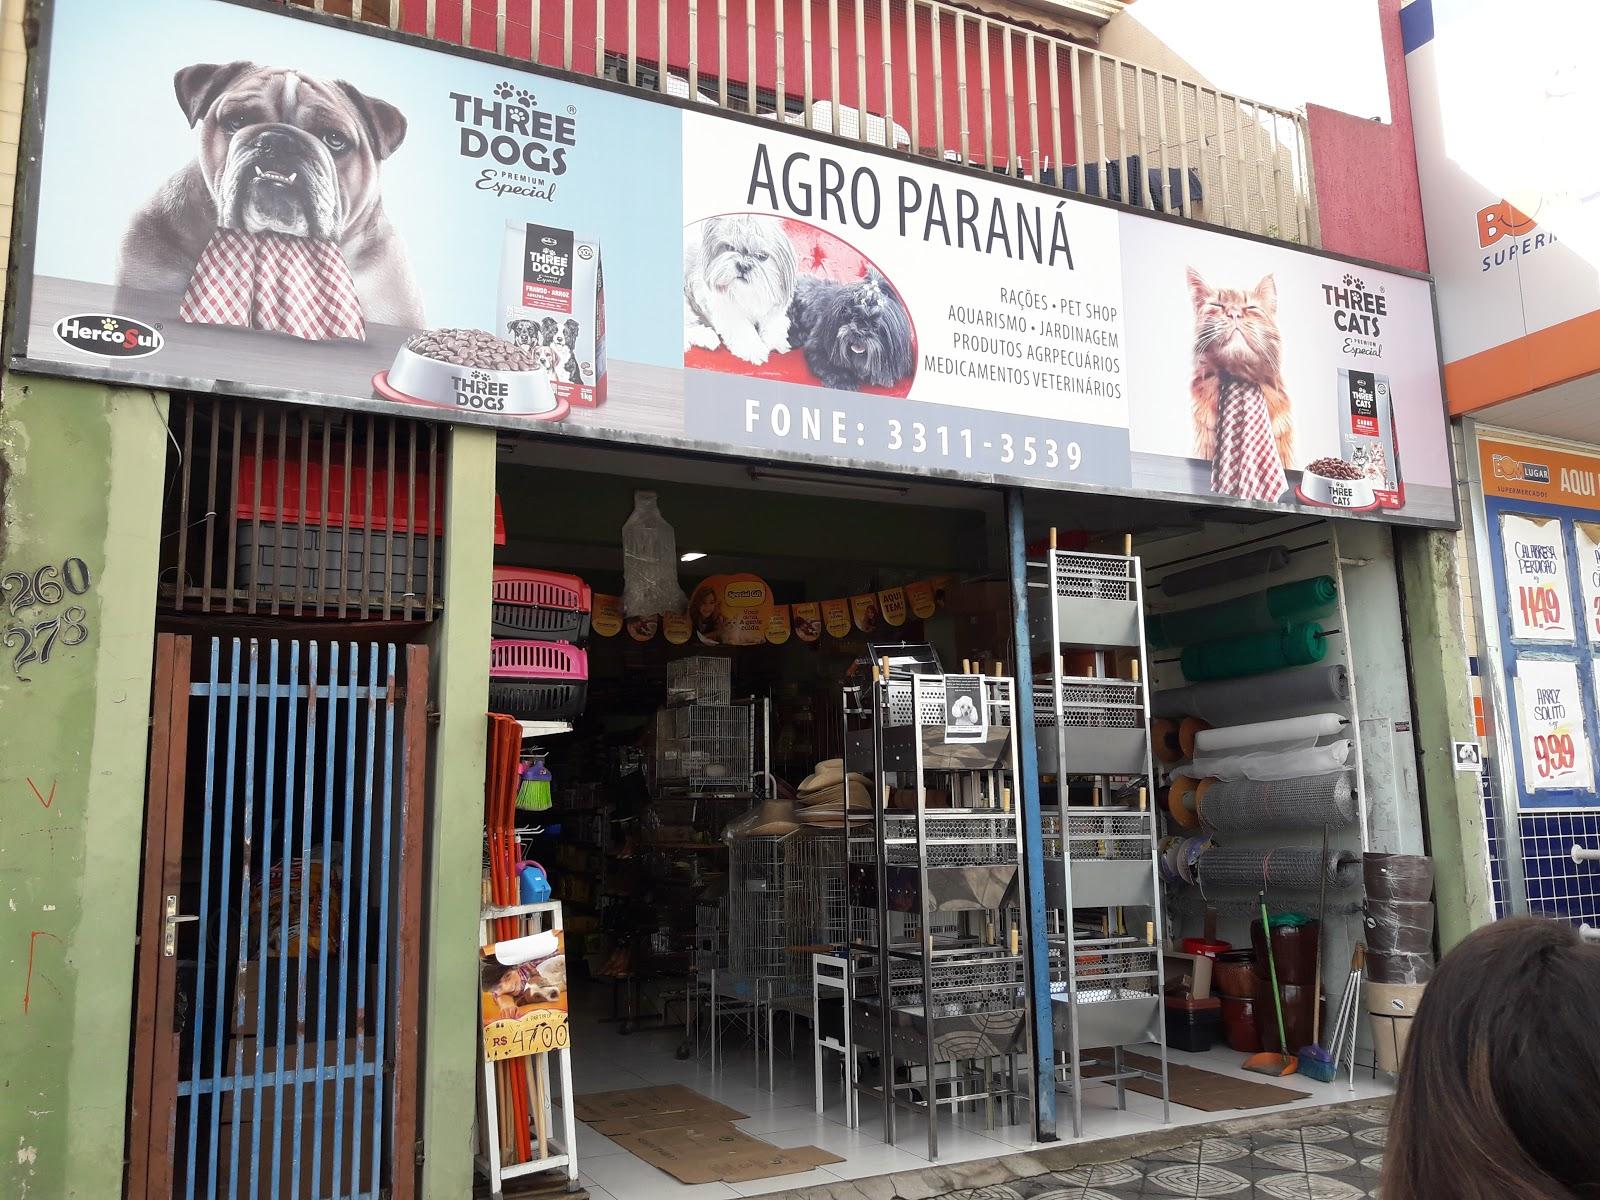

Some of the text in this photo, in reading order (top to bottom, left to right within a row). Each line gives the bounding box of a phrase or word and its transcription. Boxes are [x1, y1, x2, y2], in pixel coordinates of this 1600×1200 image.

[449, 92, 576, 146] THREE
[461, 127, 567, 175] DOGS
[475, 169, 556, 202] Especial
[501, 171, 545, 185] PREMIUM
[747, 143, 1074, 270] AGRO PARANÁ
[530, 252, 568, 267] THREE
[533, 262, 565, 276] DOGS
[1000, 287, 1117, 322] RAÇÕES PET SHOP
[1322, 284, 1386, 316] THREE
[61, 319, 159, 350] HercoSul
[948, 305, 1119, 348] AQUARISMO JARDINAGEM
[1334, 310, 1380, 337] CATS
[953, 332, 1120, 374] PRODUTOS AGRPECUÁRIOS
[1342, 337, 1382, 358] Especial
[451, 376, 509, 396] THREE
[924, 354, 1121, 399] MEDICAMENTOS VETERINÁRIOS
[456, 392, 504, 411] DOGS
[1352, 391, 1373, 401] THREE
[1355, 400, 1371, 409] CATS
[745, 399, 1081, 471] FONE: 3311-3539
[1328, 486, 1353, 496] THREE
[1525, 467, 1548, 478] LUGAR
[1560, 468, 1595, 496] AQUI
[1332, 496, 1351, 506] CATS
[1, 557, 90, 616] 260
[4, 606, 88, 673] 278
[493, 1036, 508, 1047] R$
